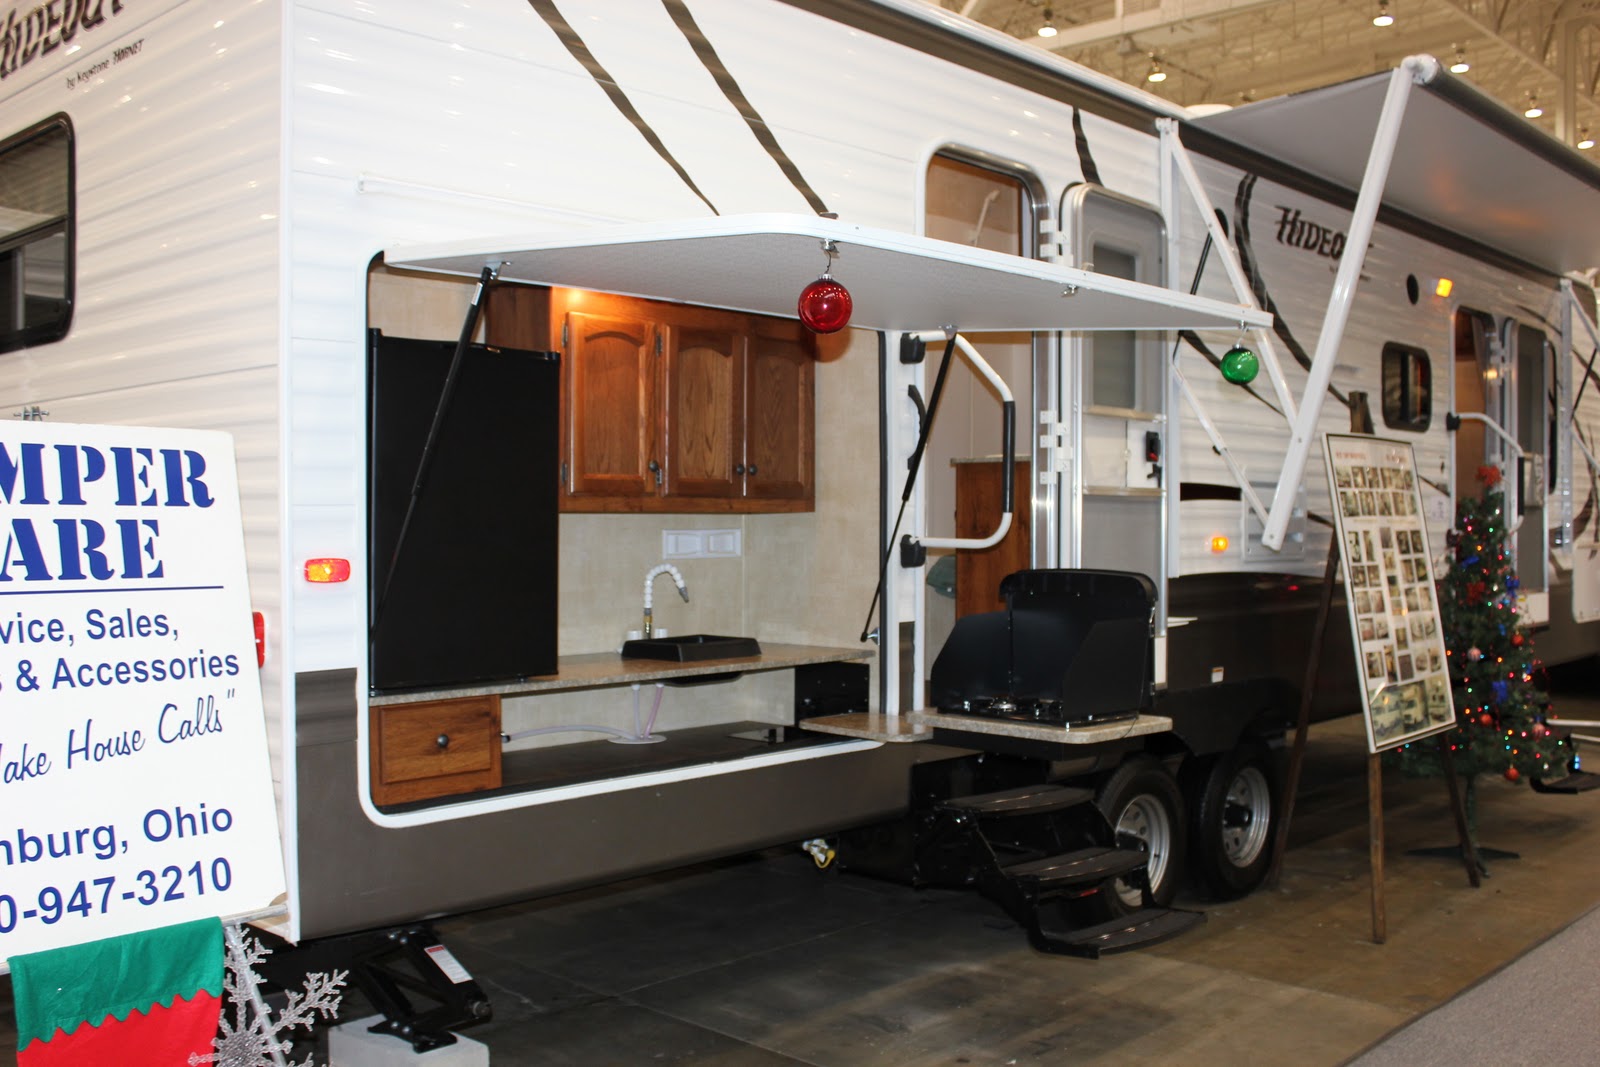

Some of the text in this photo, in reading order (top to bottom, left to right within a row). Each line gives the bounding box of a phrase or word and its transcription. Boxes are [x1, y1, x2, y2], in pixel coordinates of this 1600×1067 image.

[86, 608, 179, 641] Sales,
[16, 659, 40, 692] &
[52, 649, 240, 689] Accessories
[0, 743, 52, 784] ake
[67, 718, 145, 769] House
[143, 803, 233, 842] Ohio
